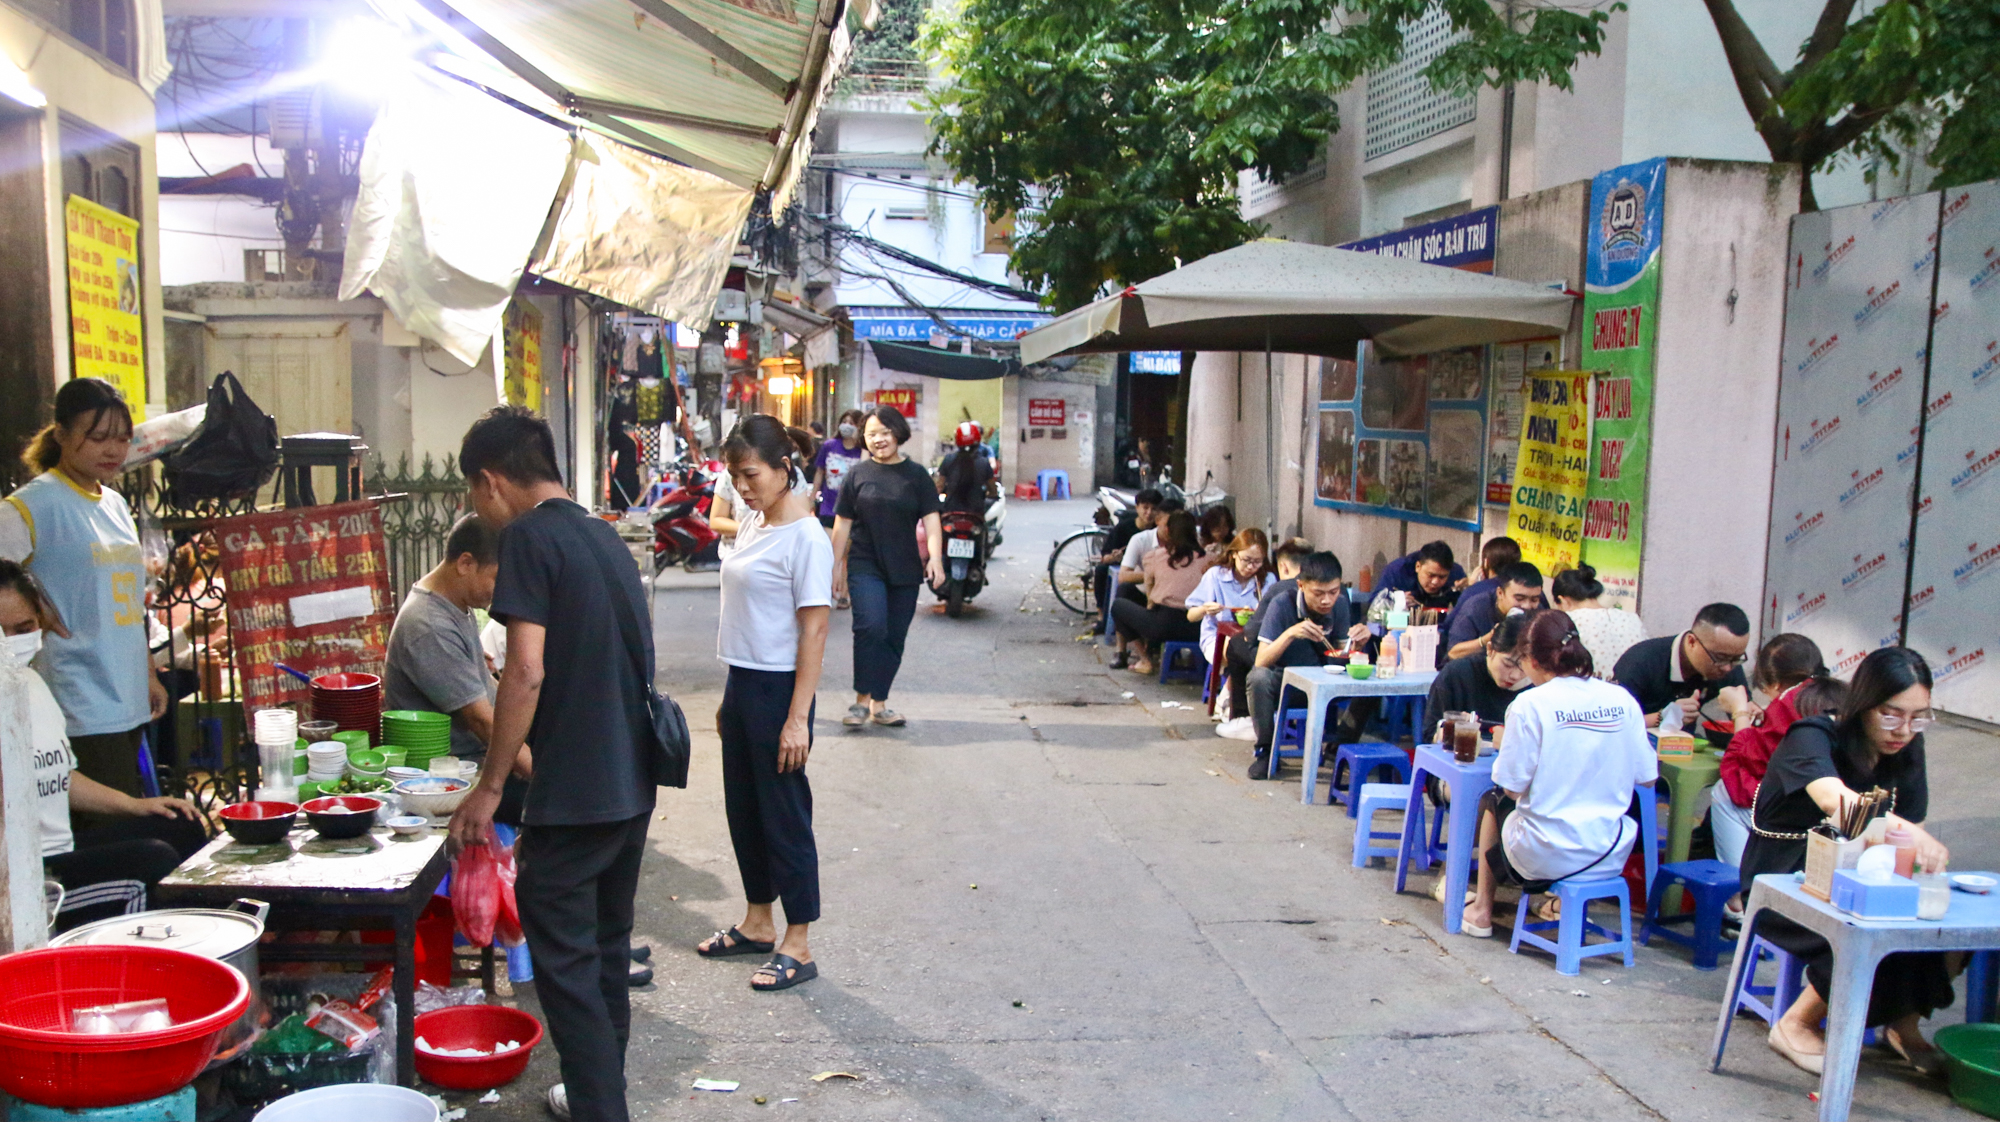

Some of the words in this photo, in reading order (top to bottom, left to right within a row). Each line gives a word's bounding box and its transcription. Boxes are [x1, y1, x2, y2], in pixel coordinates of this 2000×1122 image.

[1396, 235, 1422, 261] CHĂM
[1423, 228, 1443, 261] SÓC
[1444, 223, 1464, 257] BÁN
[1467, 215, 1487, 251] TRÚ
[870, 323, 892, 337] MÍA
[897, 323, 916, 337] ĐÁ
[224, 524, 266, 553] GÀ
[271, 513, 331, 546] TẦN
[337, 512, 376, 538] 20K
[1584, 498, 1630, 541] COVID-19
[1785, 511, 1824, 543] ALUTITAN
[230, 562, 260, 592] MỲ
[267, 558, 295, 586] GÀ
[297, 550, 338, 584] TẦN
[344, 551, 383, 576] 25K
[1841, 553, 1886, 586] ALUTITAN
[1786, 592, 1827, 622] ALUTITAN
[1933, 647, 1985, 679] ALUTITAN
[1555, 705, 1625, 722] Balenciaga
